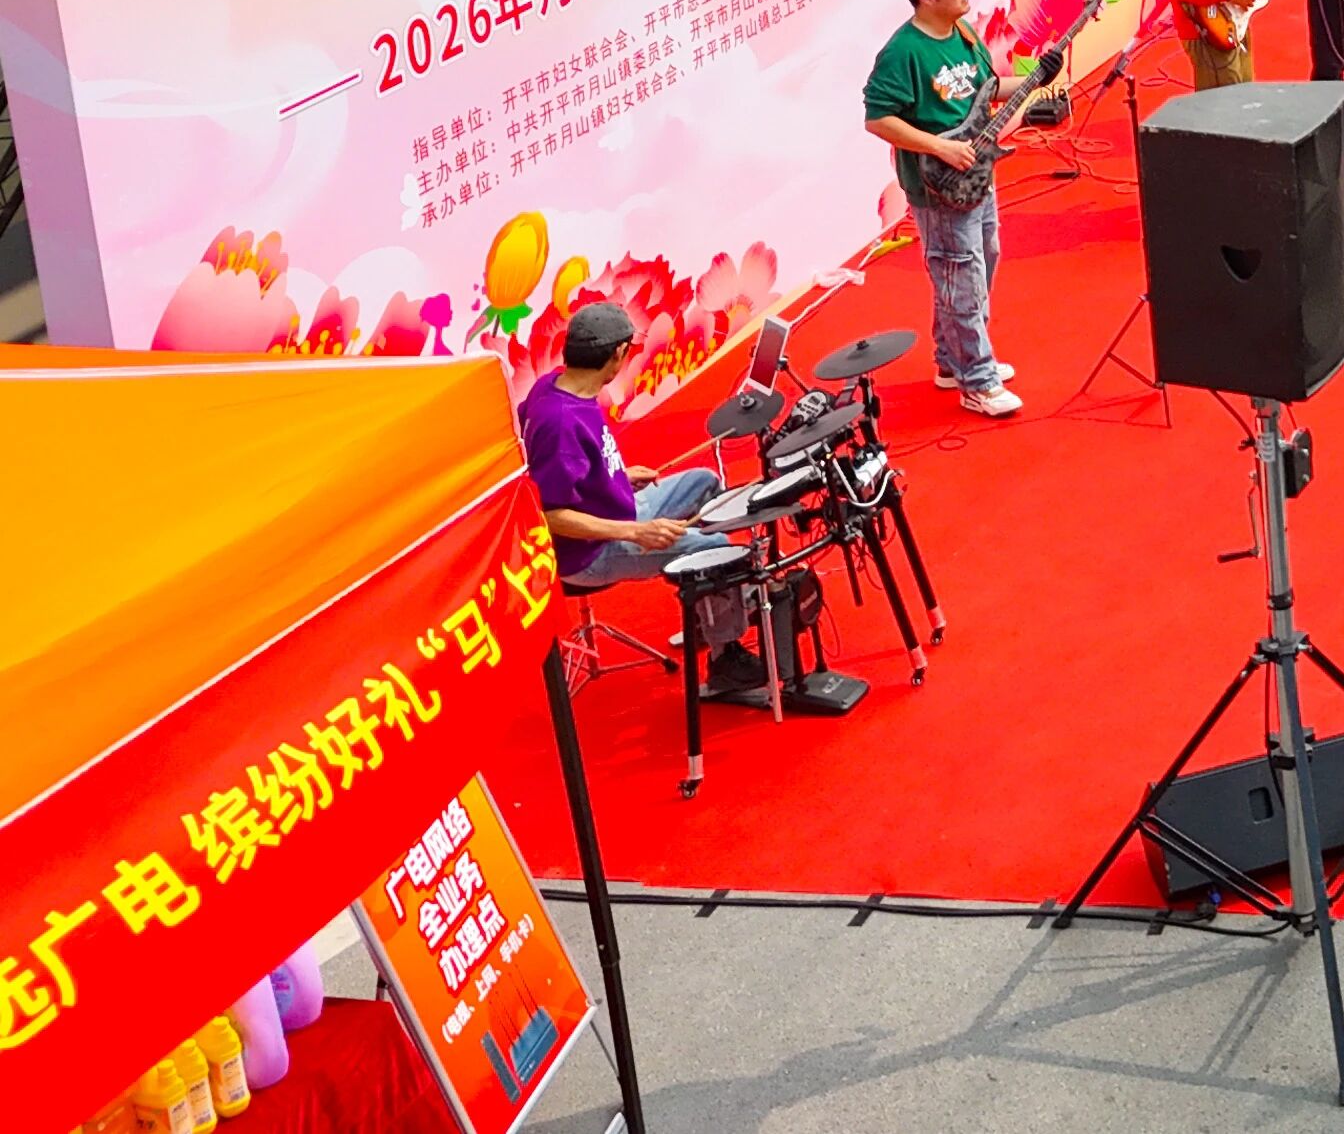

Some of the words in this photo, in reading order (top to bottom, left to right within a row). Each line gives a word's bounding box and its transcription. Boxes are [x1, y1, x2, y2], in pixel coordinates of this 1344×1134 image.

[181, 662, 441, 884] 缤纷好礼
[385, 797, 473, 919] 广电网络
[419, 851, 485, 950] 全业务
[439, 893, 506, 991] 办理点
